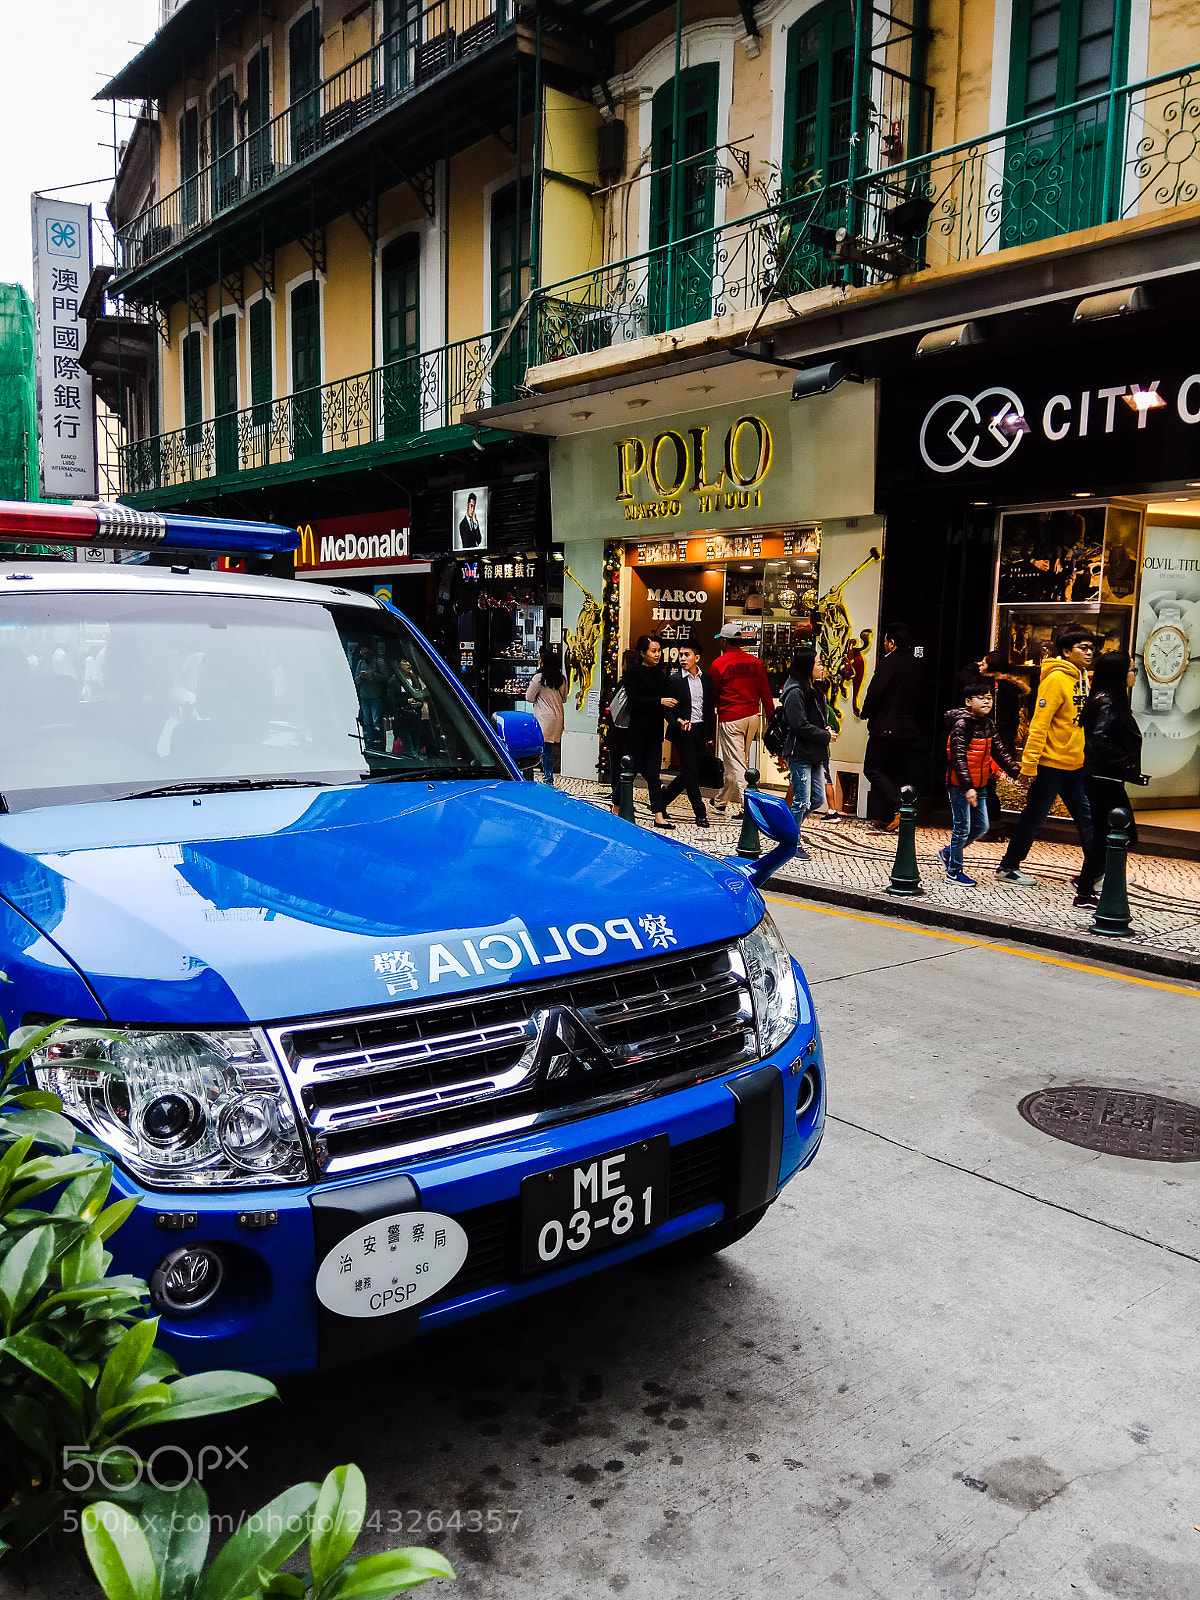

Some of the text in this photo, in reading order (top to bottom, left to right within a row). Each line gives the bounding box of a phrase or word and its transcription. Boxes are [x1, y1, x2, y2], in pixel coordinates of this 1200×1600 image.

[51, 266, 81, 439] 澳門國際銀行
[1042, 380, 1161, 441] CITY
[614, 414, 774, 502] POLO
[624, 499, 683, 521] MARCO
[1142, 556, 1174, 571] OLVIL
[646, 588, 708, 603] MARCO
[651, 607, 703, 622] HIUUI
[661, 624, 692, 640] 全店
[638, 913, 678, 949] 察
[369, 950, 419, 996] 警
[573, 1153, 626, 1210] ME
[537, 1186, 652, 1262] 03-81
[339, 1223, 446, 1274] 治安警察局
[415, 1262, 429, 1274] SG
[369, 1283, 417, 1310] CPSP
